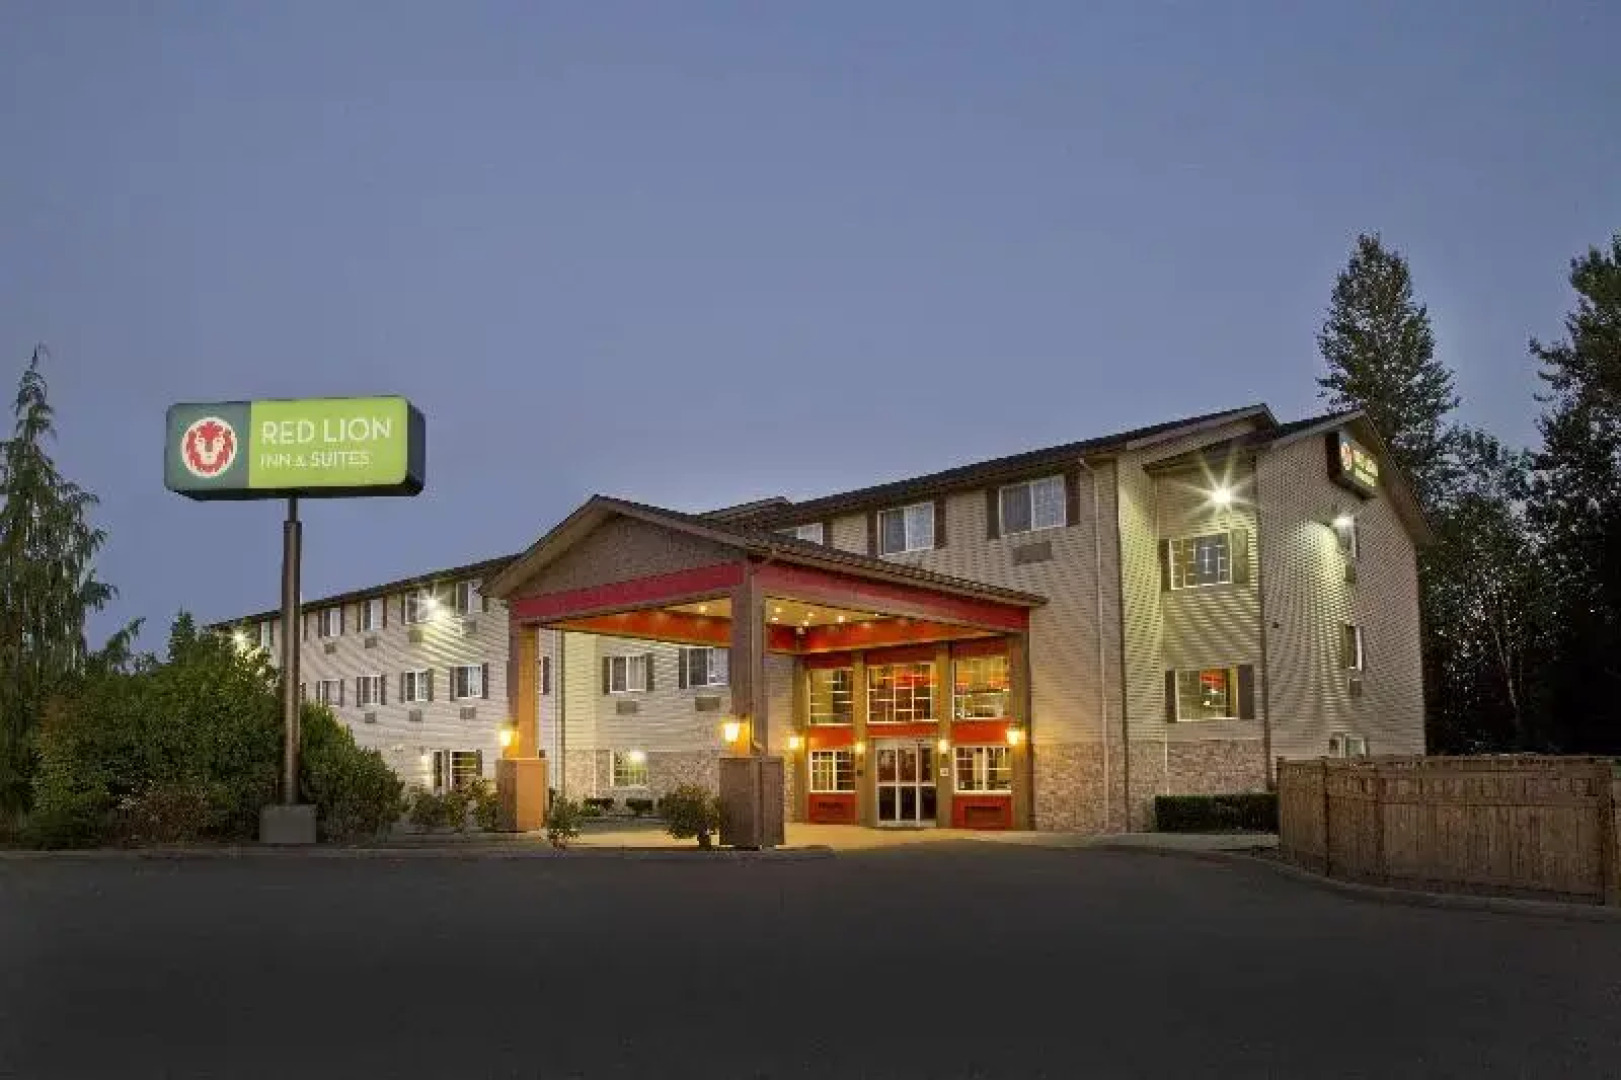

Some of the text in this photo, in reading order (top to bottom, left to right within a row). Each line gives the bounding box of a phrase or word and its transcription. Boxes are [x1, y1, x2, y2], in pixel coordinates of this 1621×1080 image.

[261, 416, 392, 445] RED LION
[260, 450, 371, 469] INN & SUITES
